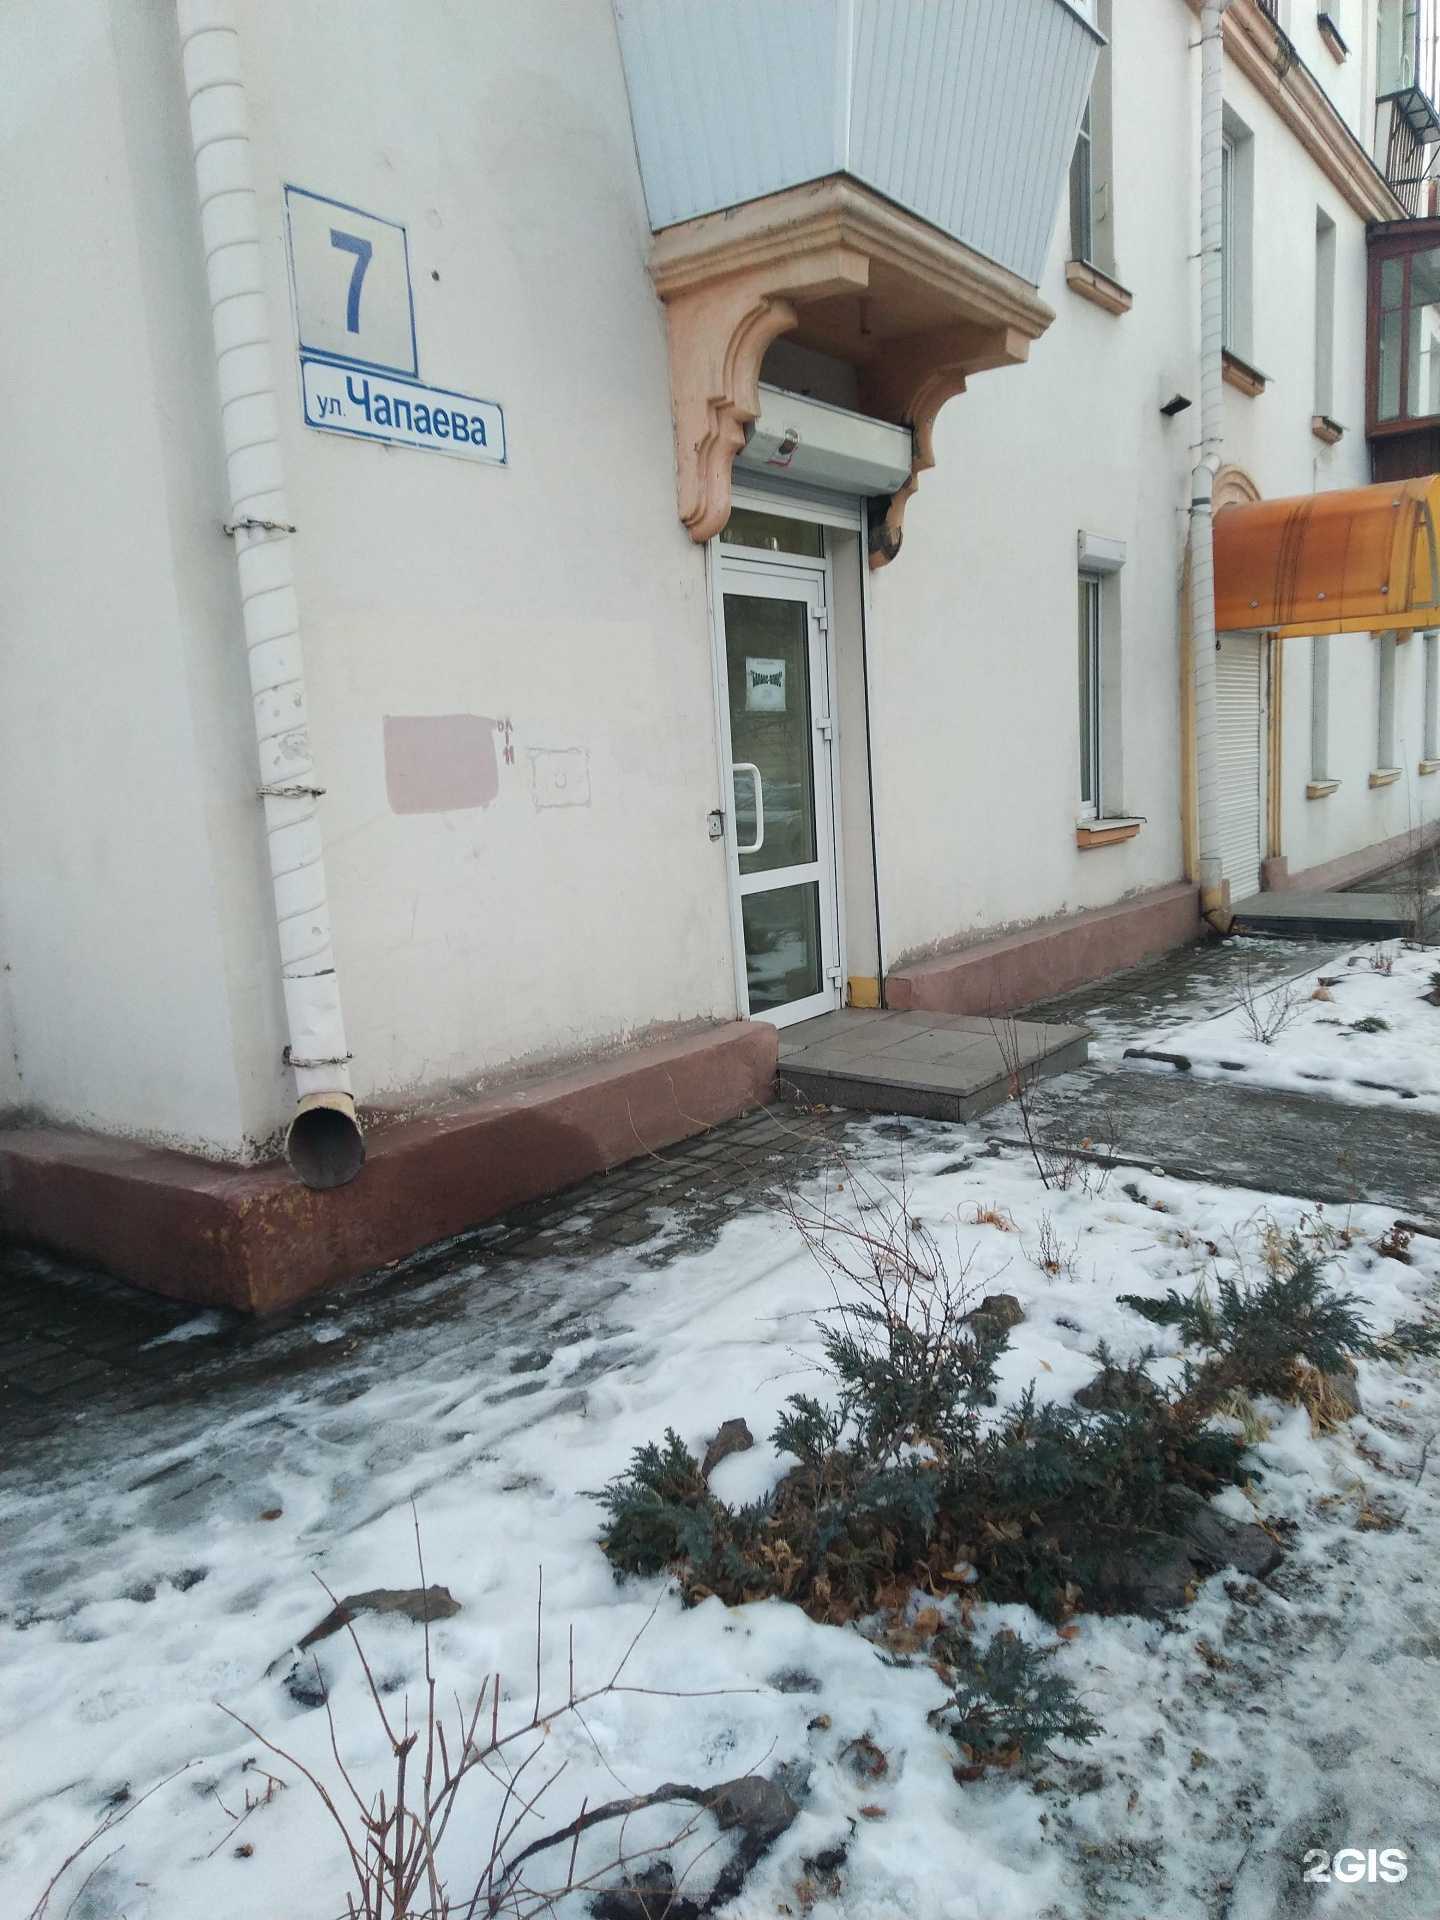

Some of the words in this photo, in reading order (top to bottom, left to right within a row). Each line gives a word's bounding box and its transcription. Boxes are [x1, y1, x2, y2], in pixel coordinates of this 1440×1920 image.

[329, 227, 373, 335] 7
[316, 393, 347, 419] ул.
[345, 375, 488, 447] Чапаева
